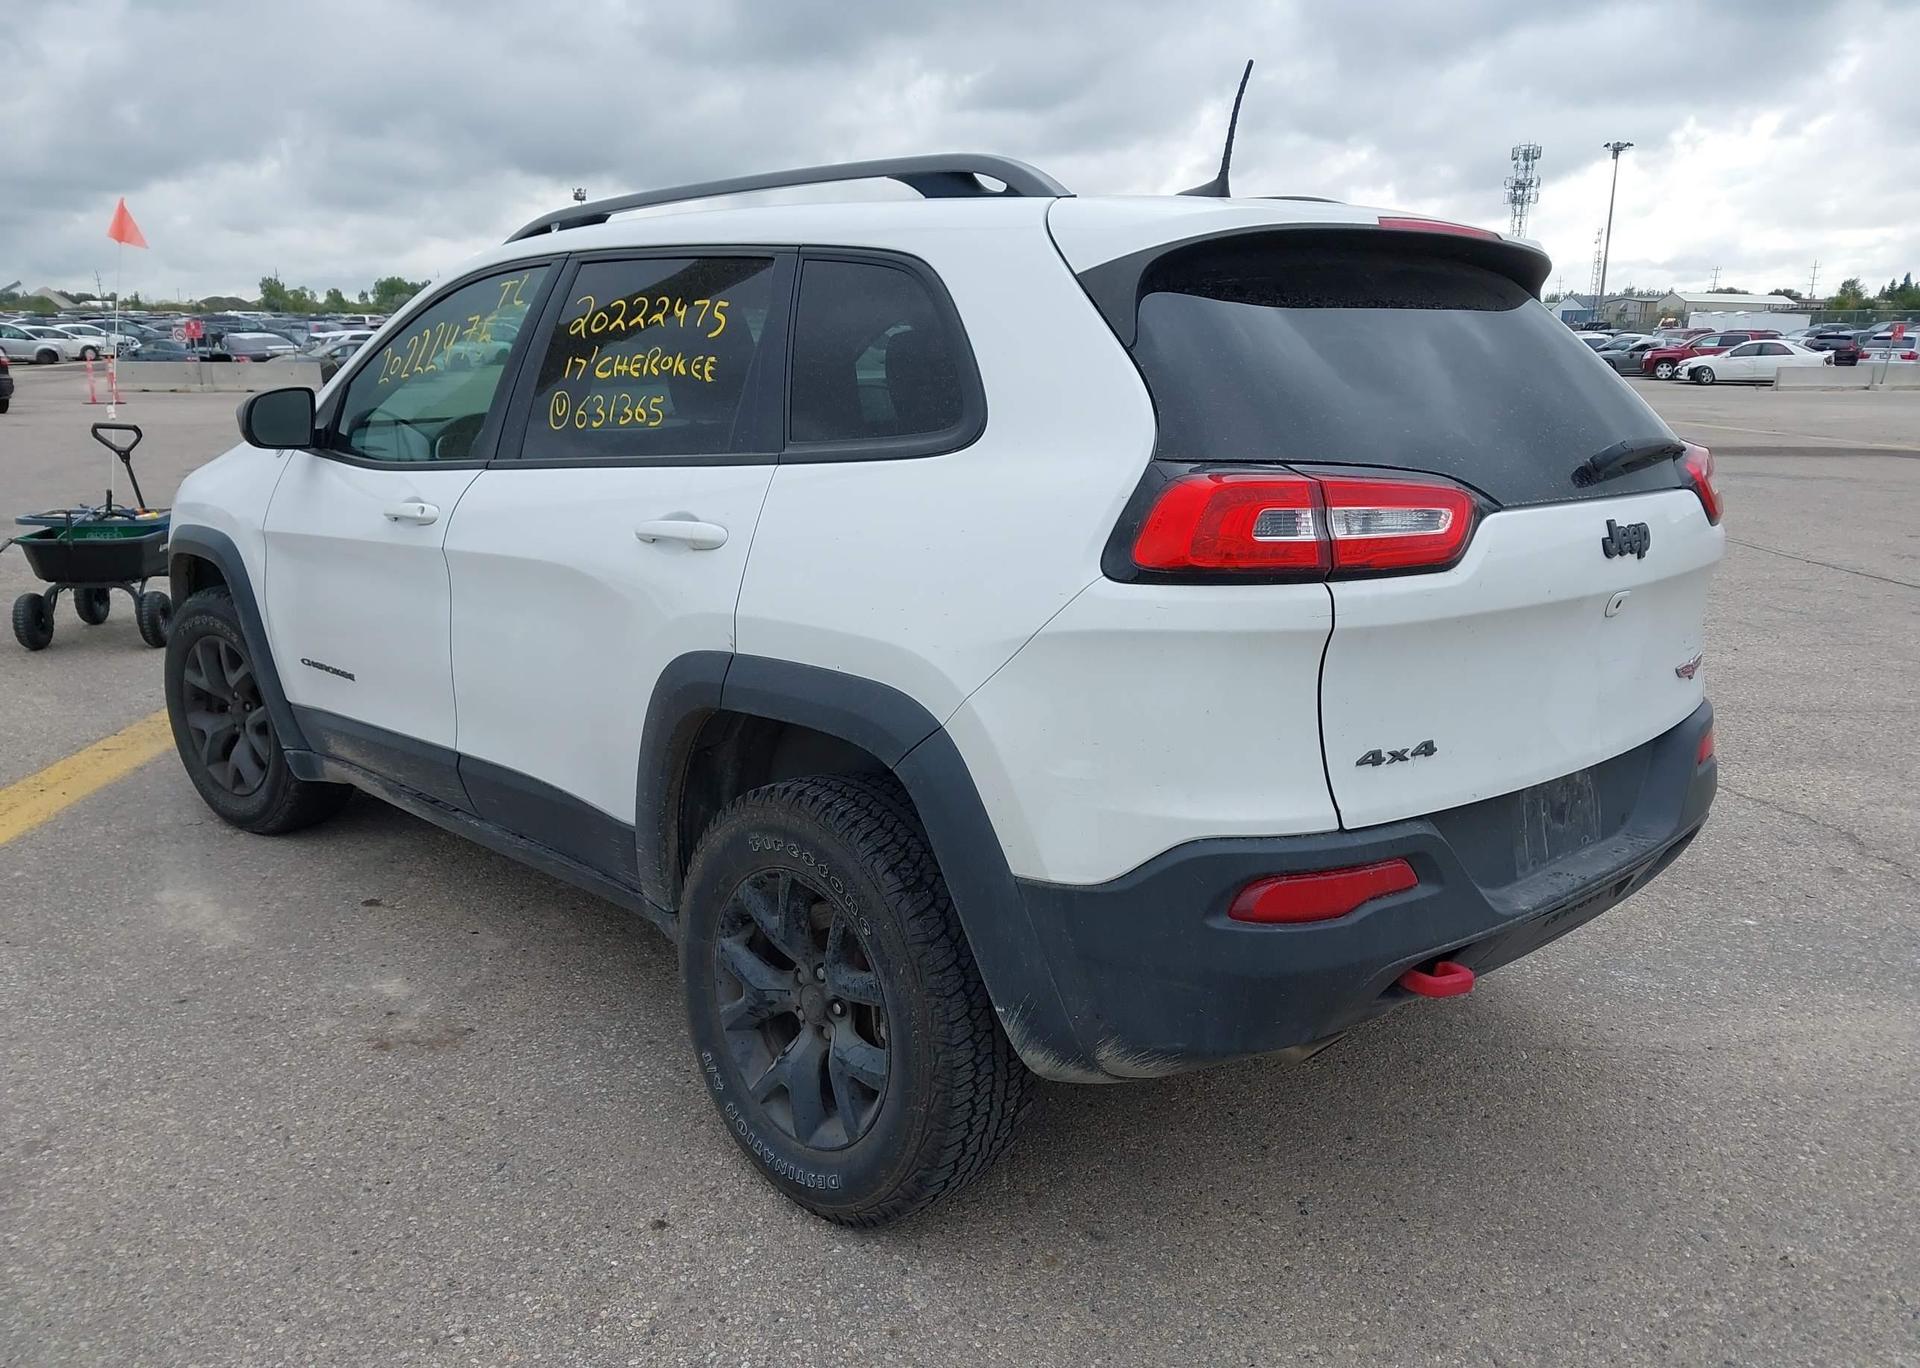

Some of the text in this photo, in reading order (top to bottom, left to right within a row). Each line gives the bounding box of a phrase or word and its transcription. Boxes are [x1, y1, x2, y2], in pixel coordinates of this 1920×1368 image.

[569, 295, 730, 340] 20222475
[575, 393, 665, 429] 631365
[1601, 519, 1651, 560] Jeep
